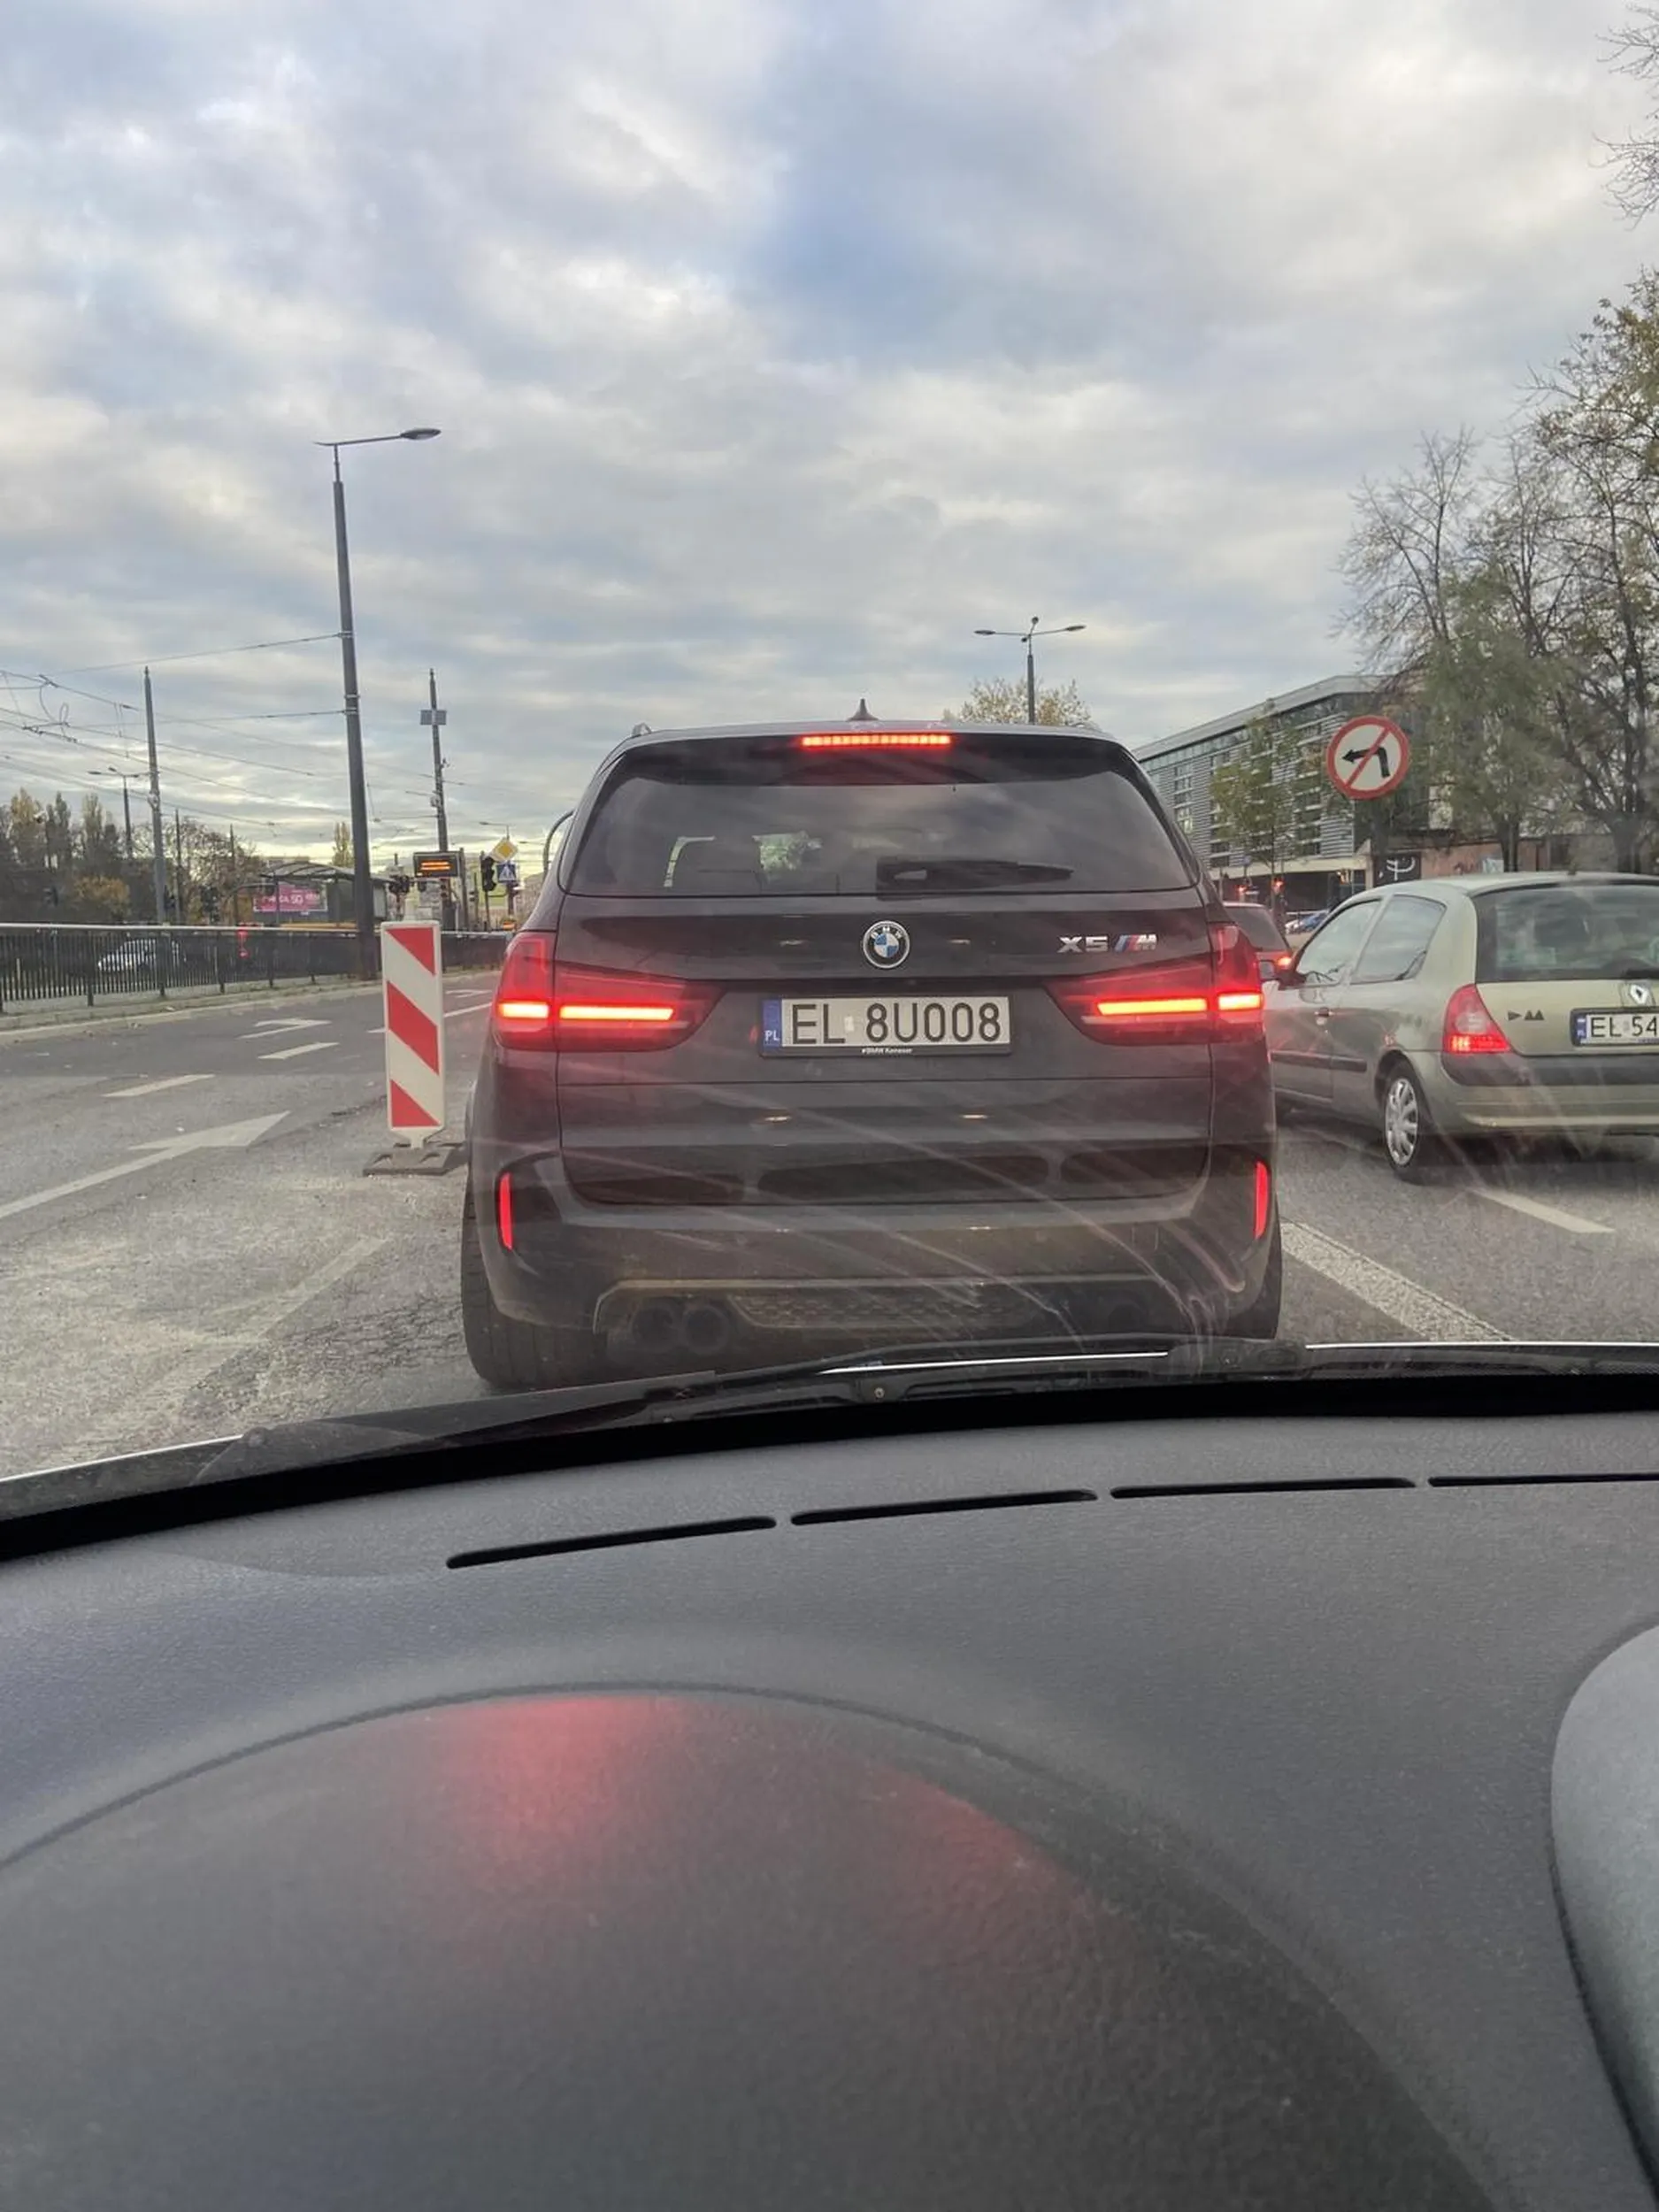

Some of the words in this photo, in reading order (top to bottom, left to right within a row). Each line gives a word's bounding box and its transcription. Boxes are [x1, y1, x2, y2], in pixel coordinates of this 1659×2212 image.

[1056, 936, 1108, 953] X5
[792, 1004, 846, 1044] EL
[866, 1002, 1001, 1042] 8U008
[1591, 1017, 1623, 1038] EL
[1632, 1016, 1657, 1037] 54
[764, 1031, 780, 1041] PL
